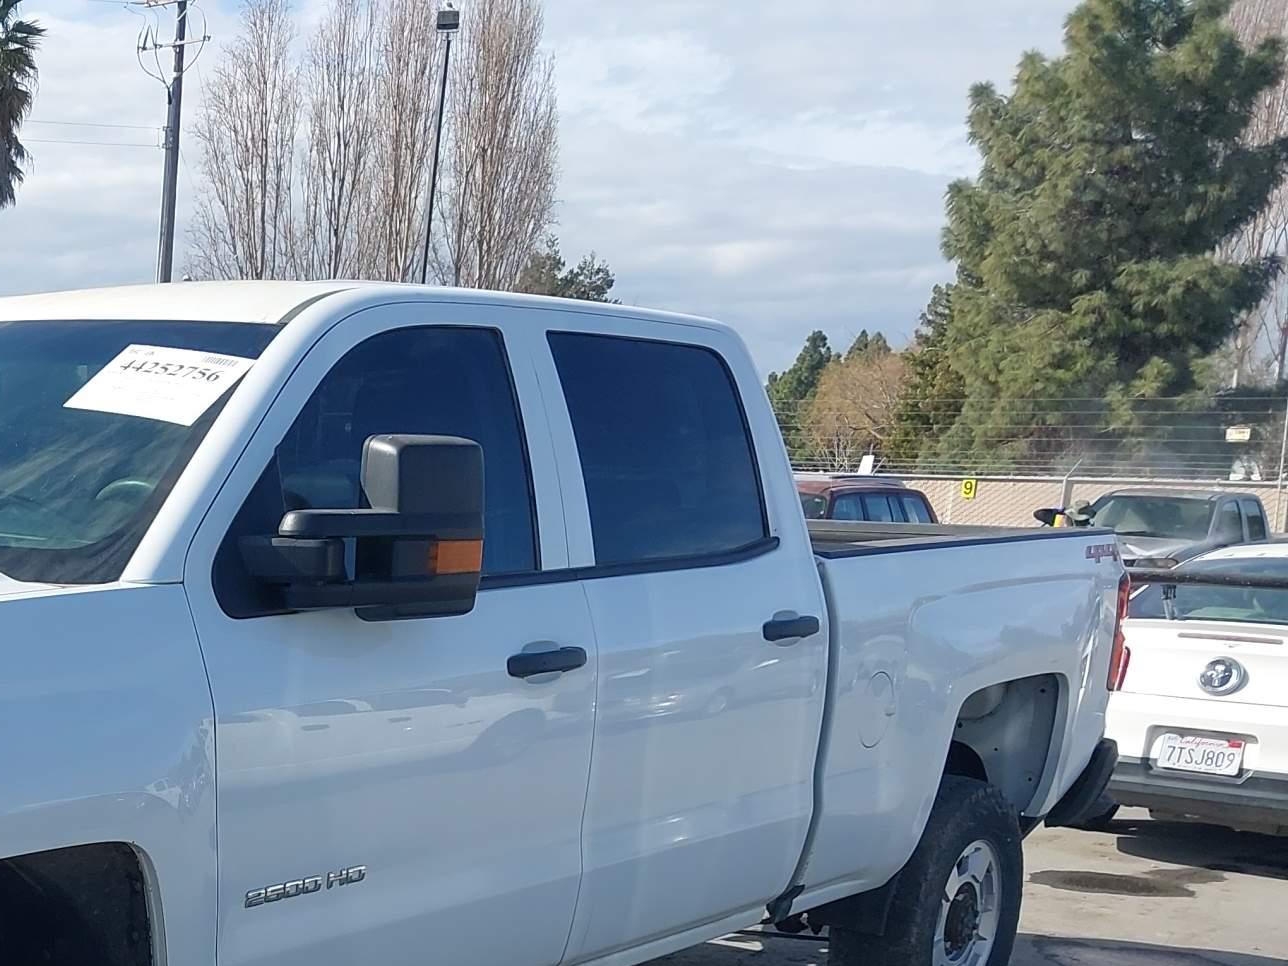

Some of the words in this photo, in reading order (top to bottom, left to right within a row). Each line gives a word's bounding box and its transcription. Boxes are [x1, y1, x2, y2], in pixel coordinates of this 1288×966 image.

[119, 359, 225, 382] 44252756
[964, 481, 973, 495] 9
[1167, 745, 1236, 769] 7TSJ809
[244, 875, 323, 909] 2500
[327, 864, 367, 889] HD
